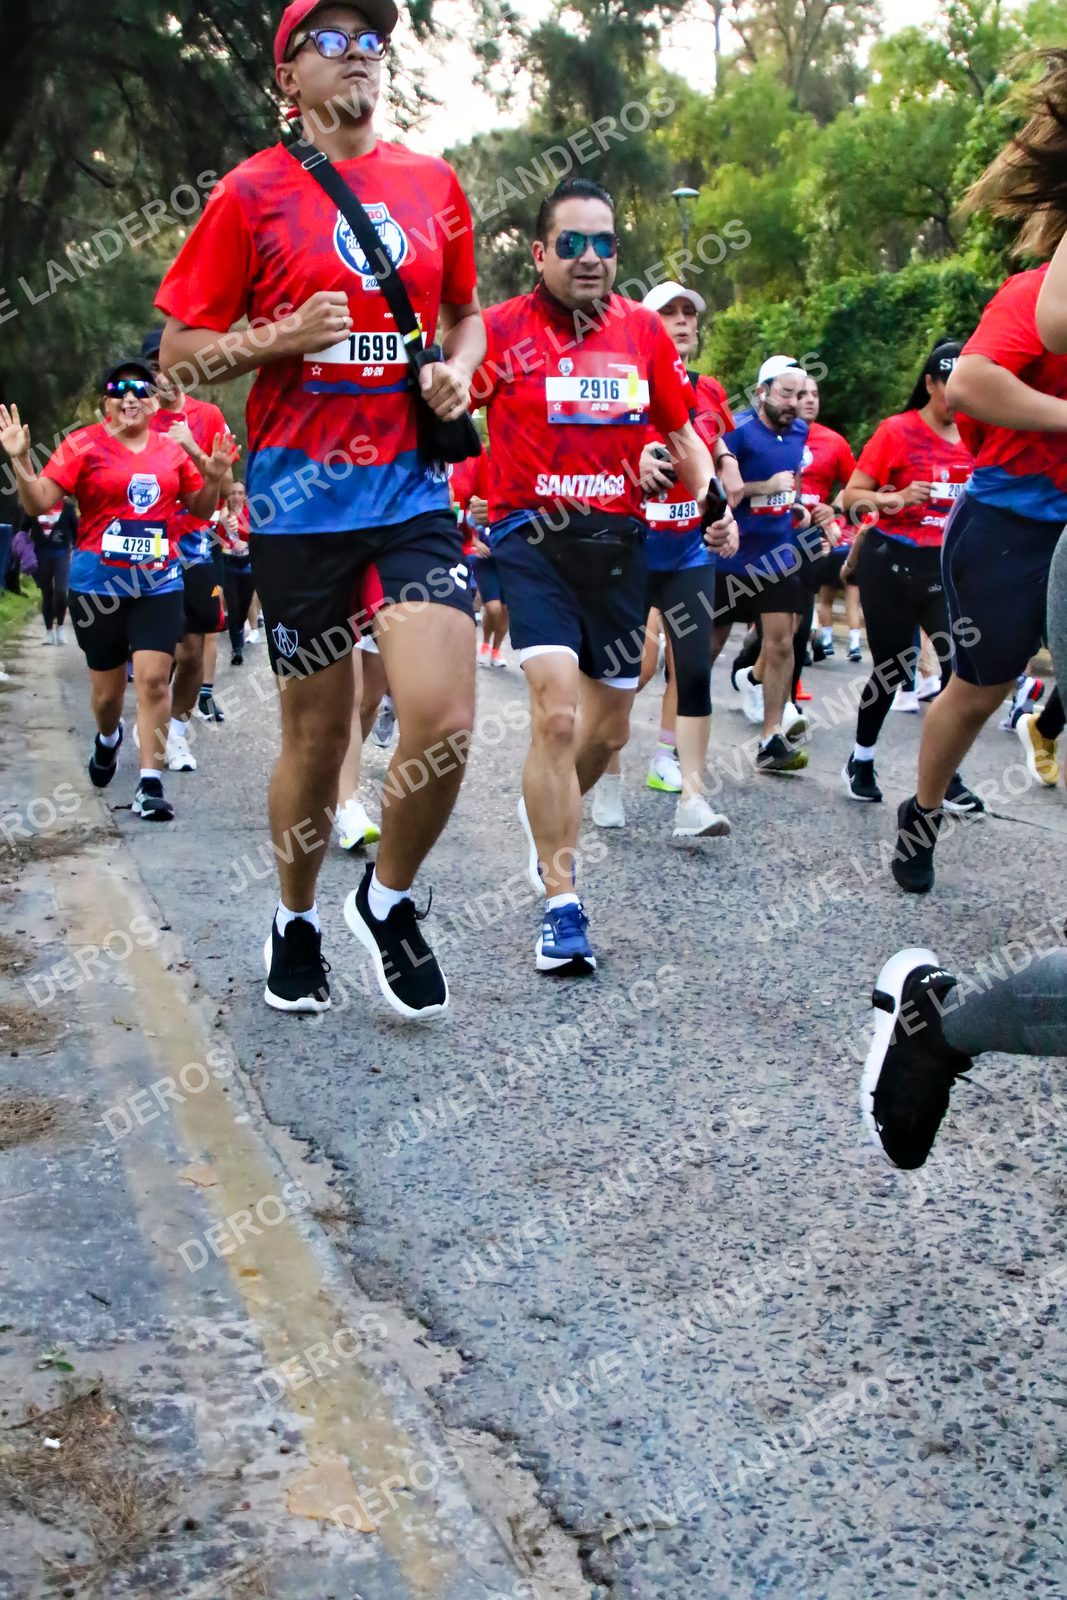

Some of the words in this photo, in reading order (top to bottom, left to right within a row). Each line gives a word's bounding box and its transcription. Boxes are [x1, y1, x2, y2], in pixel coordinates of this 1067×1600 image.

[348, 335, 398, 361] 1699
[579, 378, 620, 400] 2916
[948, 484, 964, 498] 20
[669, 501, 696, 519] 3438
[123, 538, 151, 553] 4729
